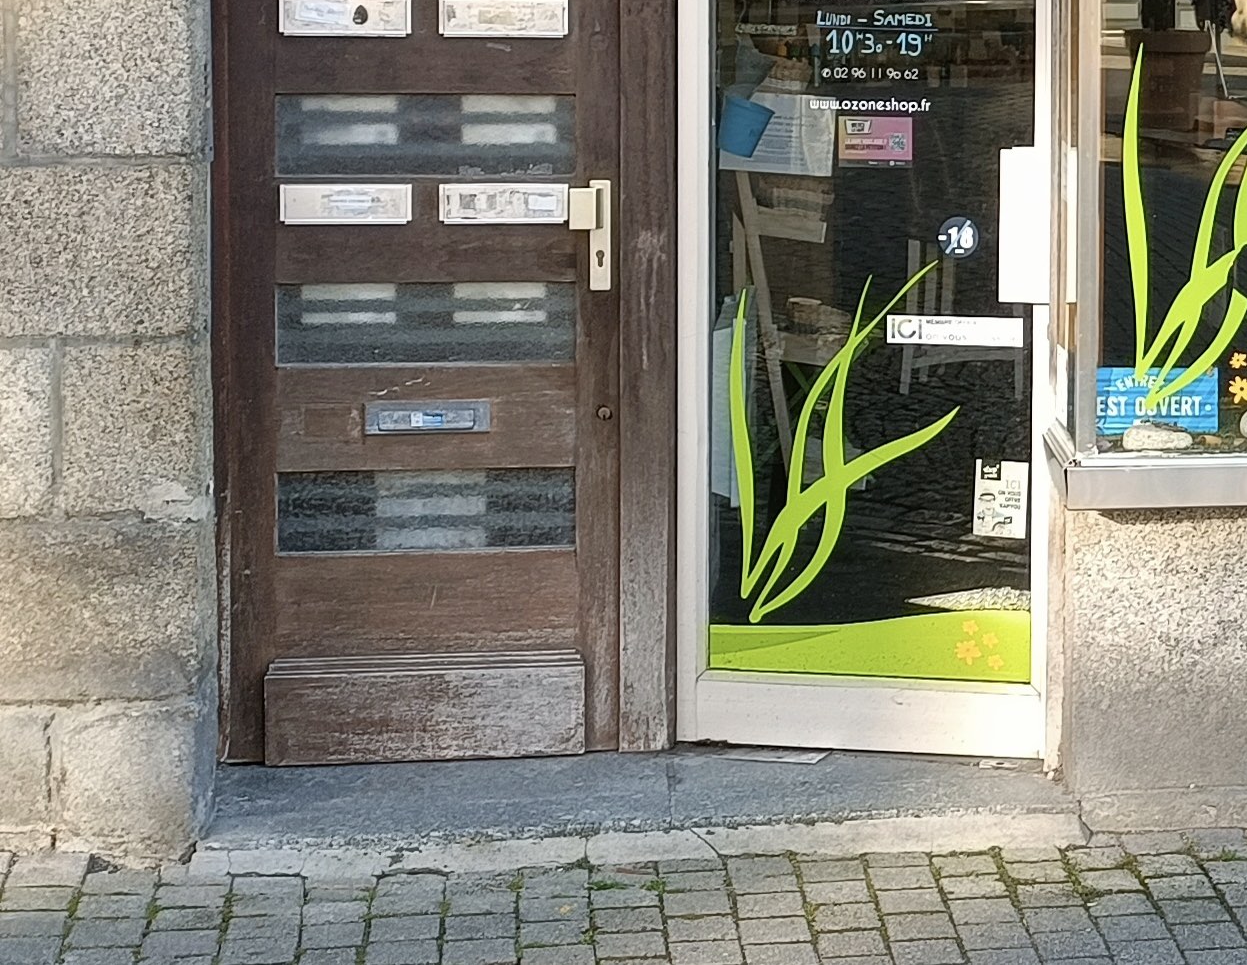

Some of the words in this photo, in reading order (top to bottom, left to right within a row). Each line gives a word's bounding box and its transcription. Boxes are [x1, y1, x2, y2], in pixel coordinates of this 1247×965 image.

[816, 10, 851, 26] LUNDI
[873, 10, 933, 27] SAMEDI
[833, 67, 849, 80] 02
[851, 67, 867, 80] 96
[871, 67, 882, 80] 11
[886, 68, 901, 80] 90
[904, 68, 919, 81] 62
[809, 97, 931, 115] www.ozoneshop.fr
[1115, 374, 1165, 391] ENTRE
